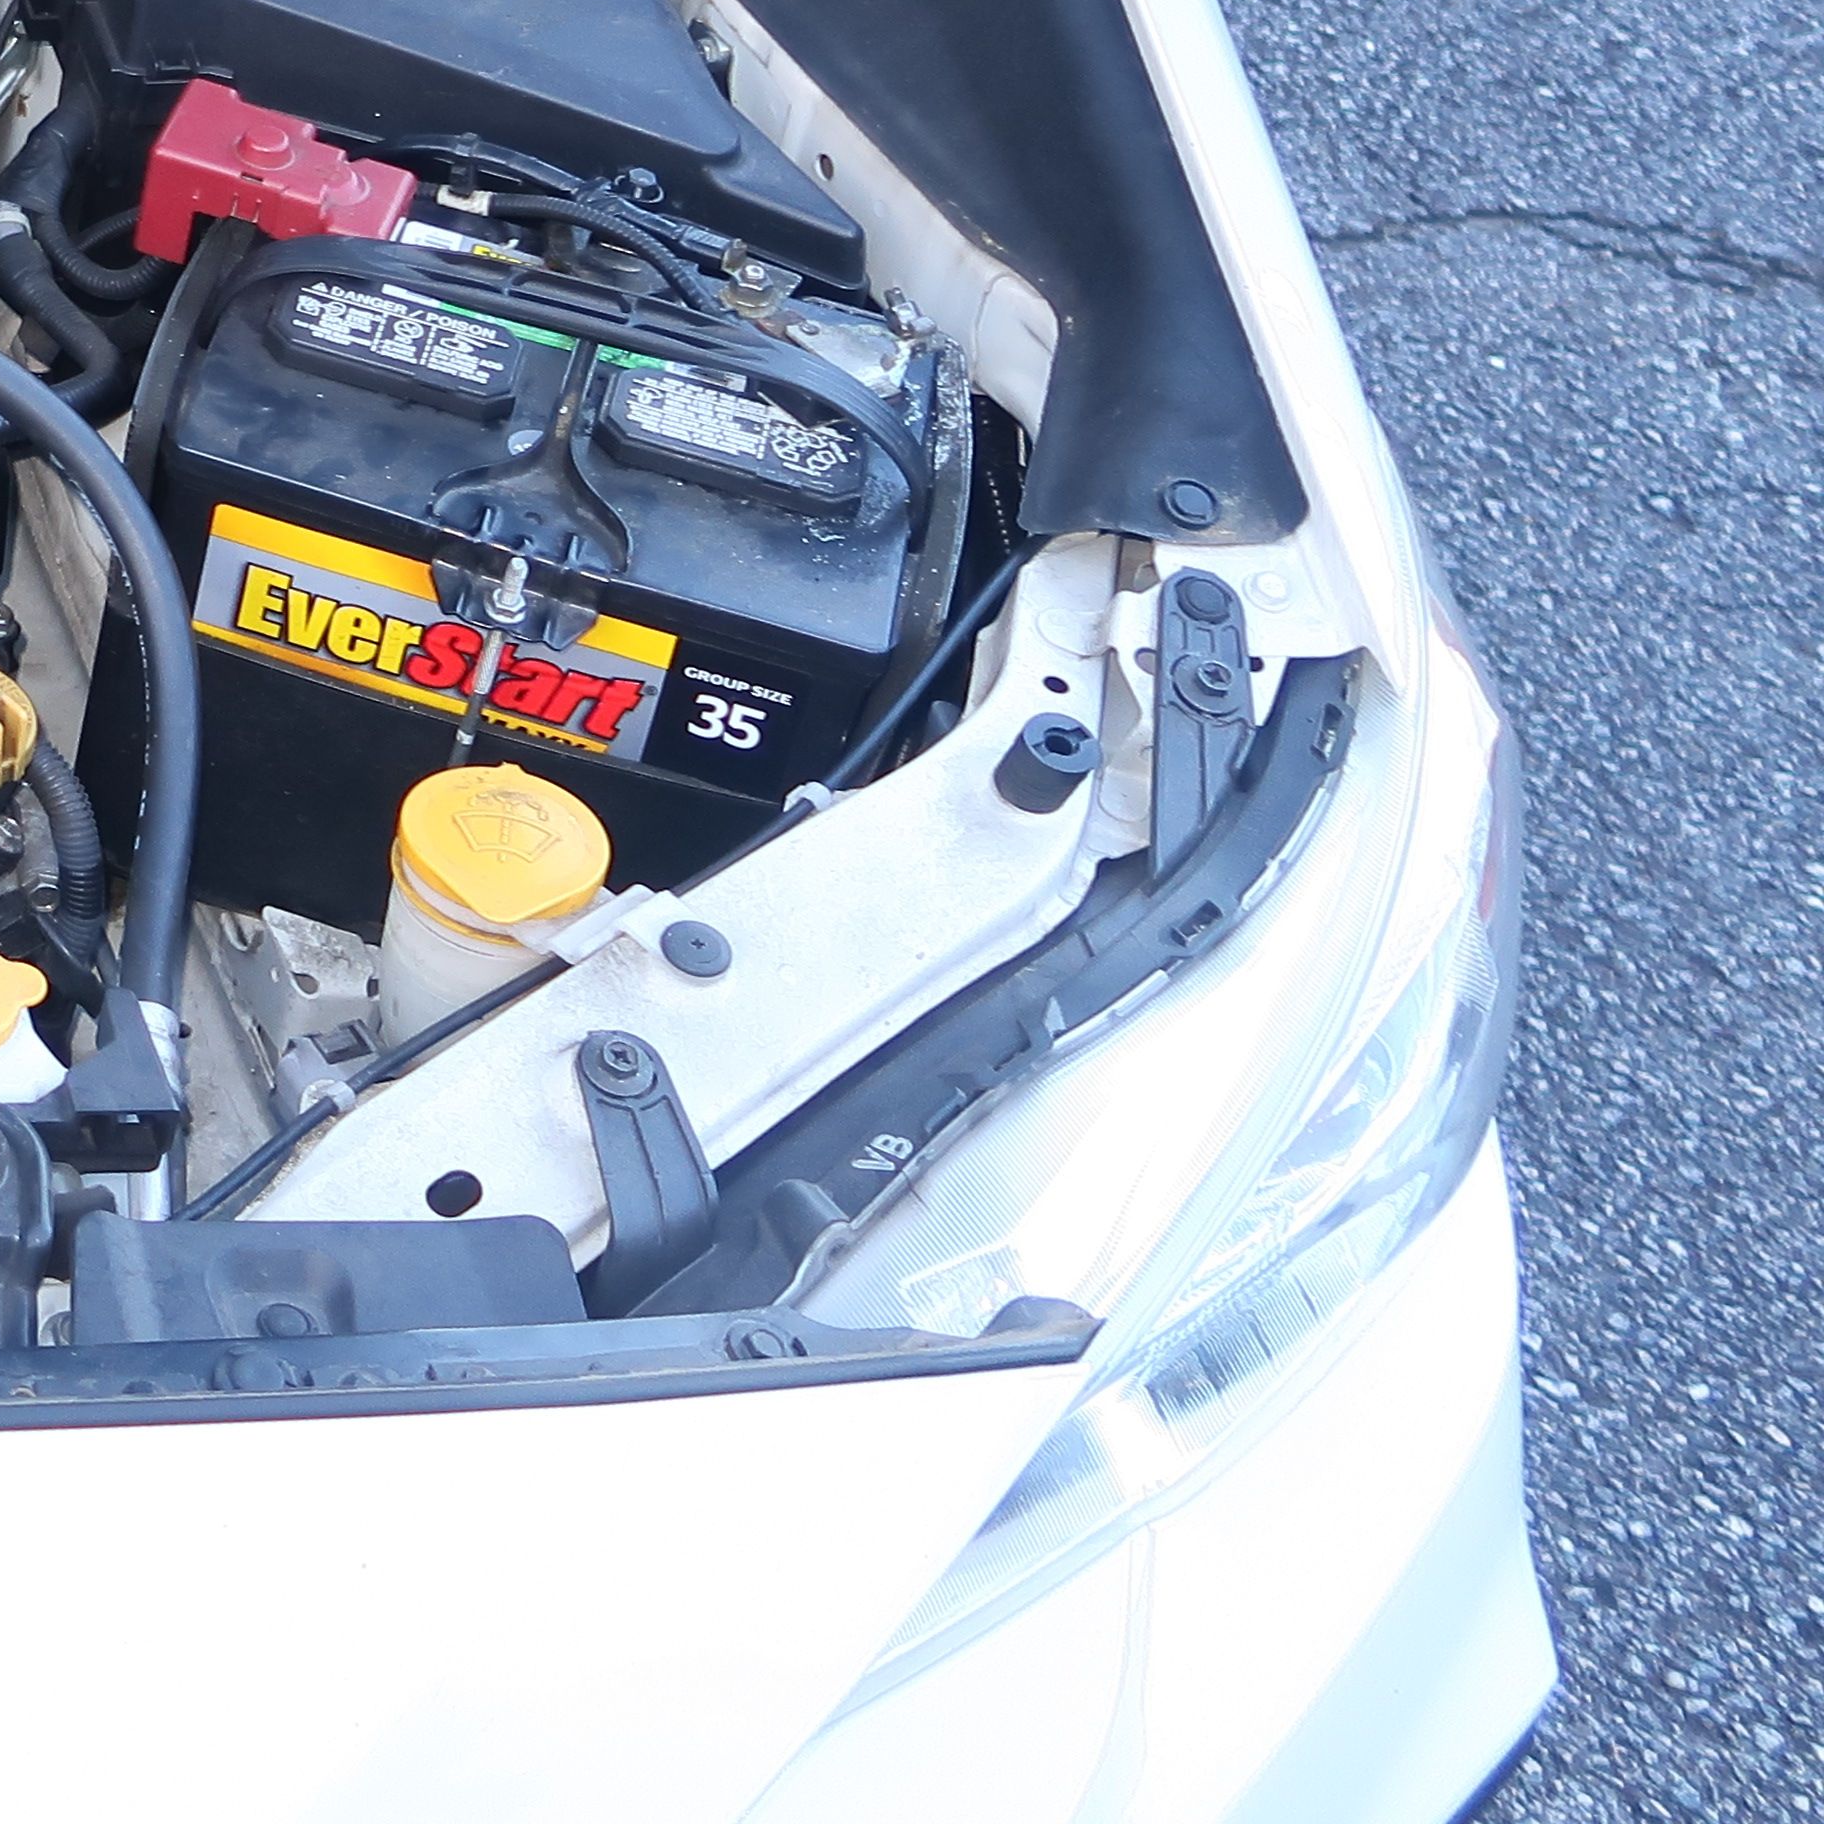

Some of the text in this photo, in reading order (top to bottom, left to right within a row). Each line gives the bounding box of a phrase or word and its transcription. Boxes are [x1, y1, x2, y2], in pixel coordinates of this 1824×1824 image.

[330, 286, 409, 316] DANGER
[425, 311, 499, 341] POISON
[683, 666, 794, 707] GROUP SIZE
[687, 693, 768, 750] 35
[850, 1133, 915, 1172] VB
